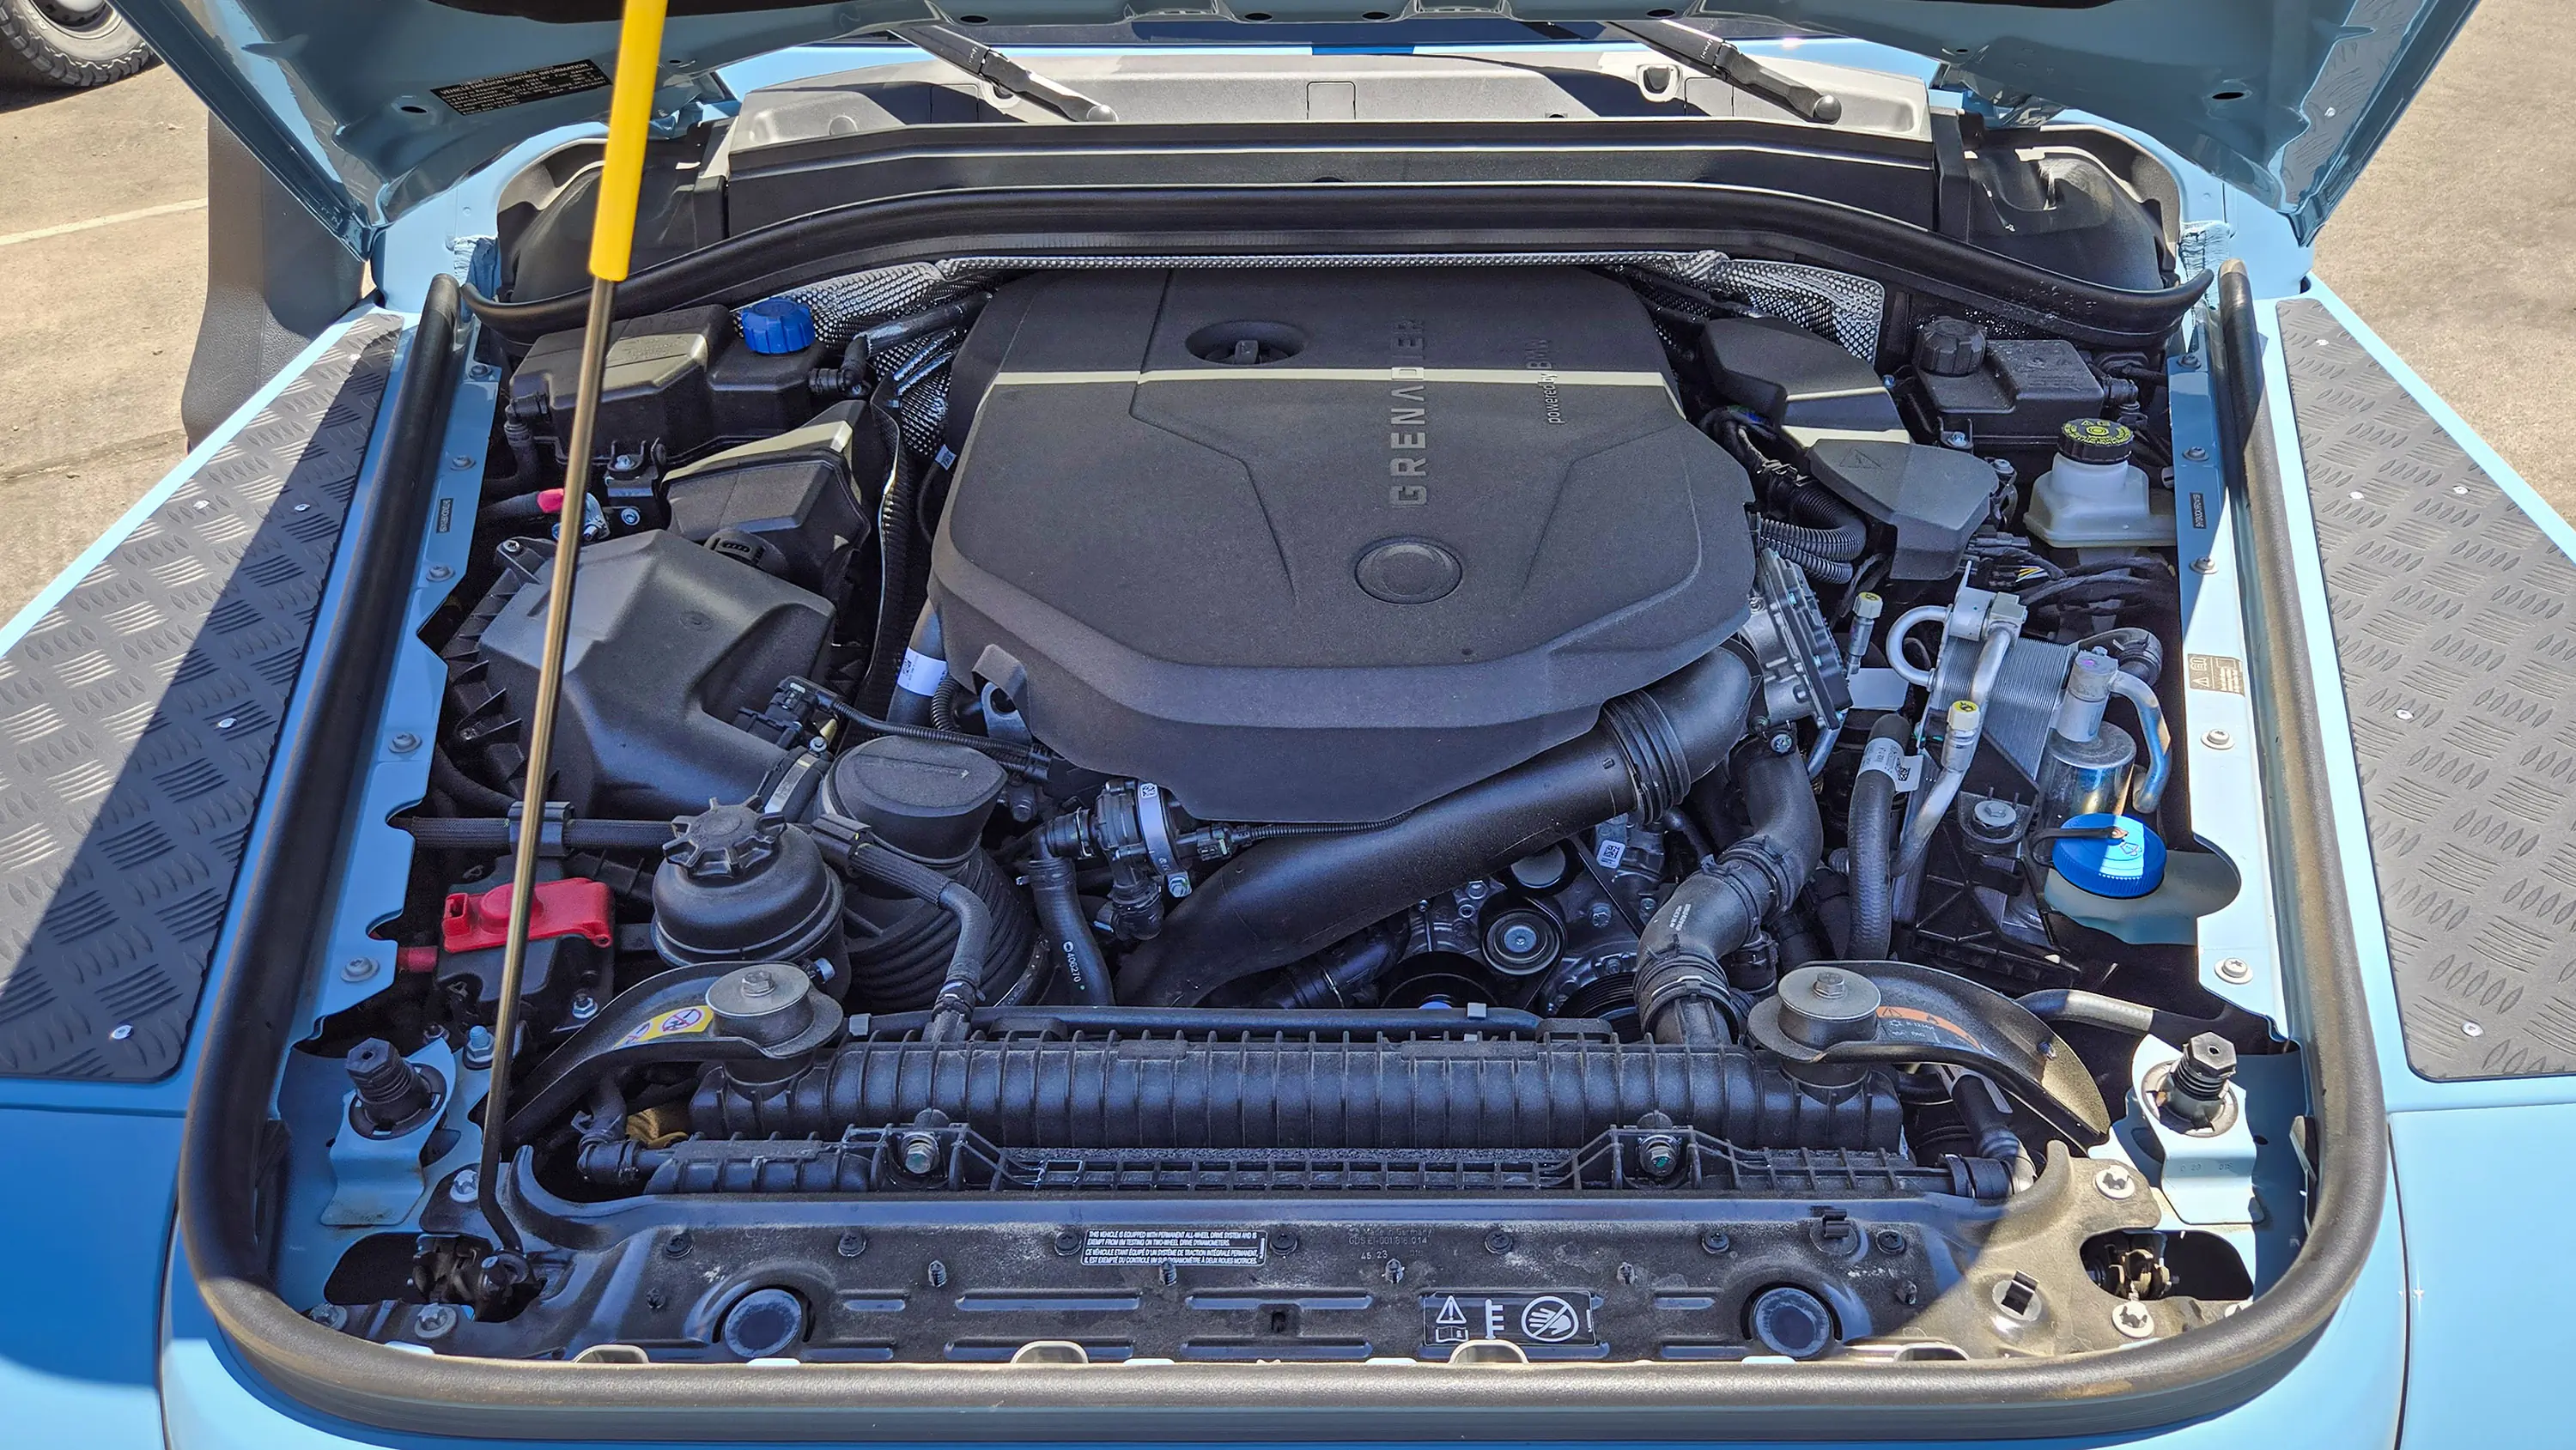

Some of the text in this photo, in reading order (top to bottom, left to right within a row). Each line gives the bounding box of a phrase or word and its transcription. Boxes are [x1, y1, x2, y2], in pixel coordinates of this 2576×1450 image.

[1389, 319, 1427, 507] GRENADIER
[1538, 383, 1566, 424] powered
[1066, 952, 1082, 983] 406270
